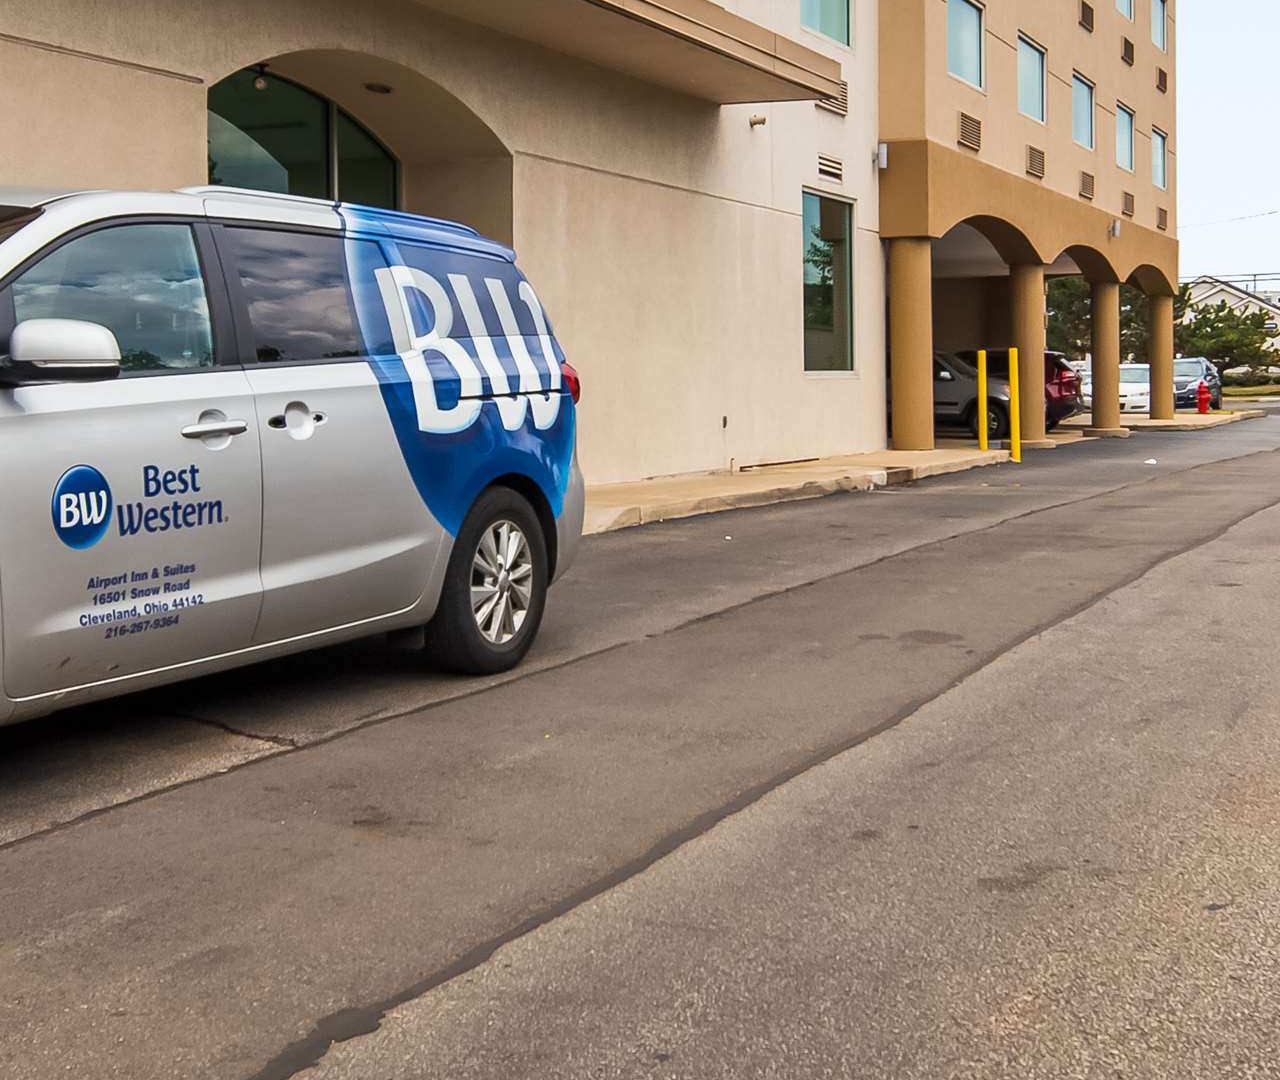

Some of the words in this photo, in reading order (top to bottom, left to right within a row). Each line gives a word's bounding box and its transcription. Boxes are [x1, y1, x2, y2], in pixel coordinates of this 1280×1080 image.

[374, 266, 561, 435] BW
[143, 464, 201, 497] Best
[59, 490, 108, 528] BW
[87, 572, 127, 589] Airport
[131, 570, 148, 582] Inn
[151, 567, 160, 579] &
[163, 563, 196, 577] Suites
[92, 590, 126, 606] 16501
[130, 586, 160, 599] Snow
[163, 579, 191, 593] Road
[79, 605, 141, 626] Cleveland,
[143, 601, 169, 614] Ohio
[171, 594, 204, 609] 44142
